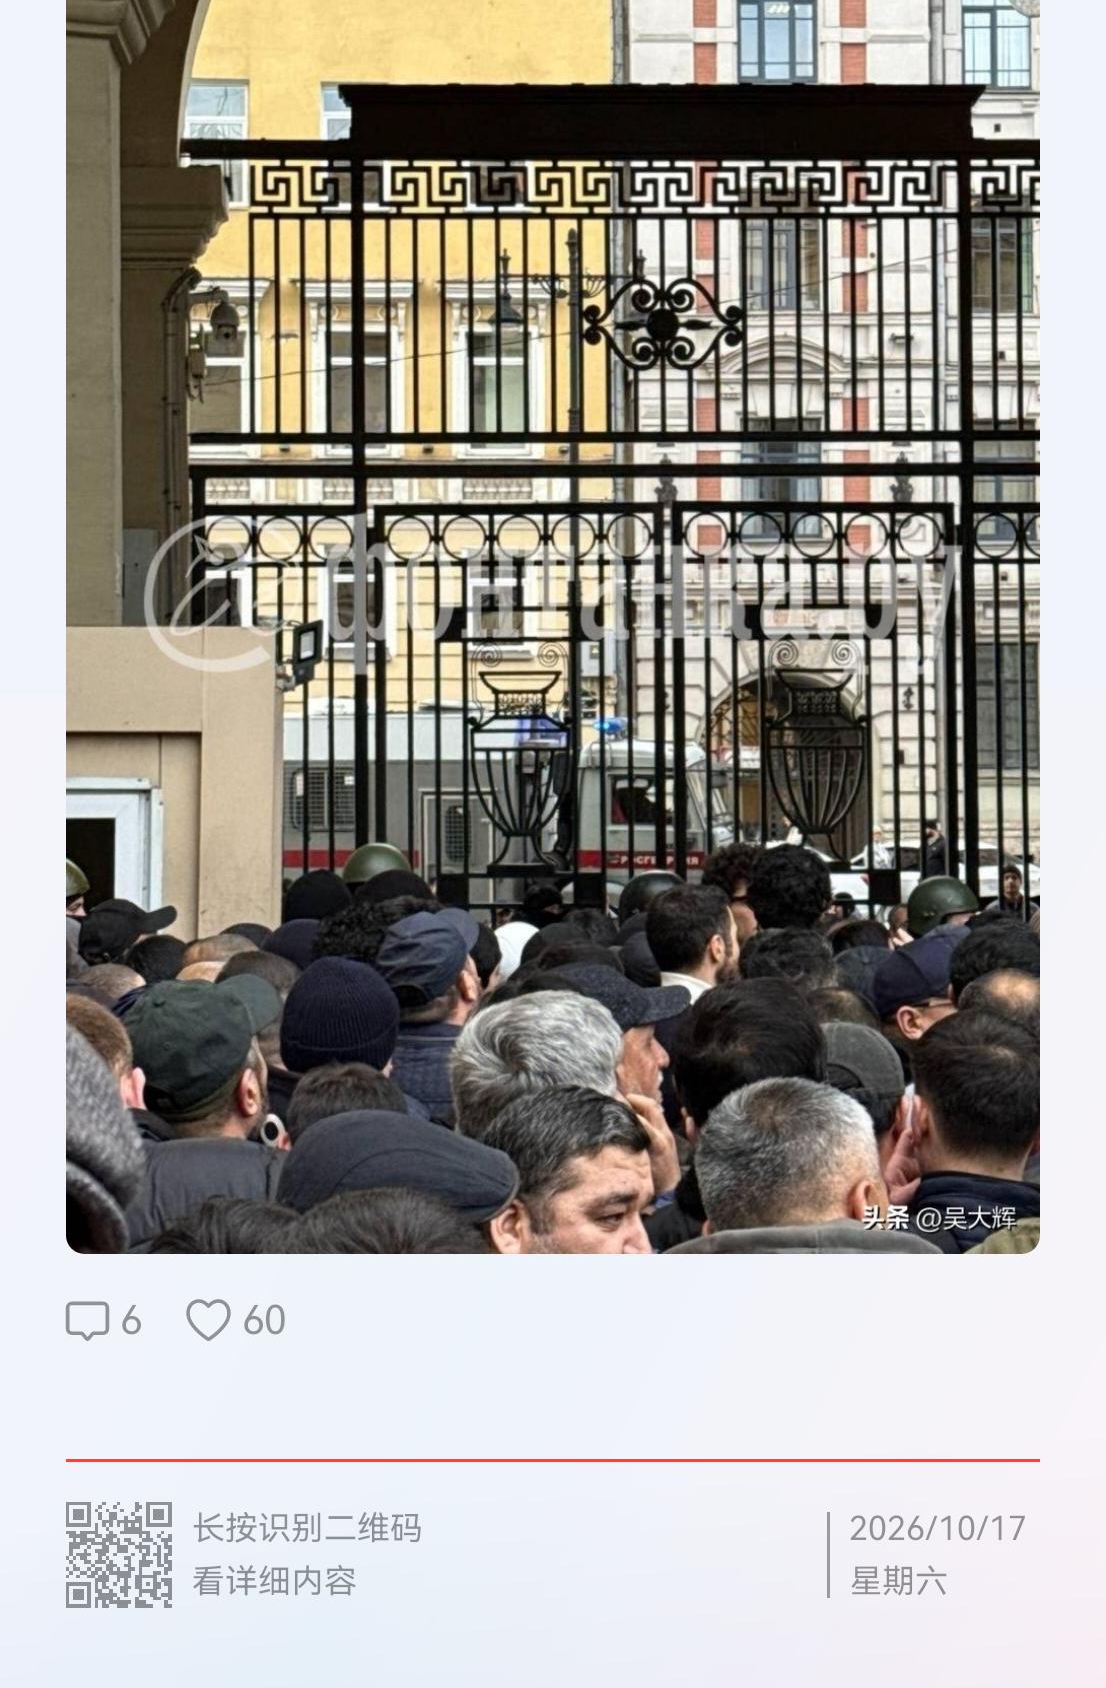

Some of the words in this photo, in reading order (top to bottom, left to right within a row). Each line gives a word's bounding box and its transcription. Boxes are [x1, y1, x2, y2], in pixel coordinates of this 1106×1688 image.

[121, 1304, 142, 1335] 6
[243, 1303, 286, 1336] 60
[193, 1511, 422, 1544] 长按识别二维码
[849, 1514, 1026, 1542] 2026/10/17
[193, 1563, 357, 1597] 看详细内容
[850, 1564, 948, 1597] 星期六
